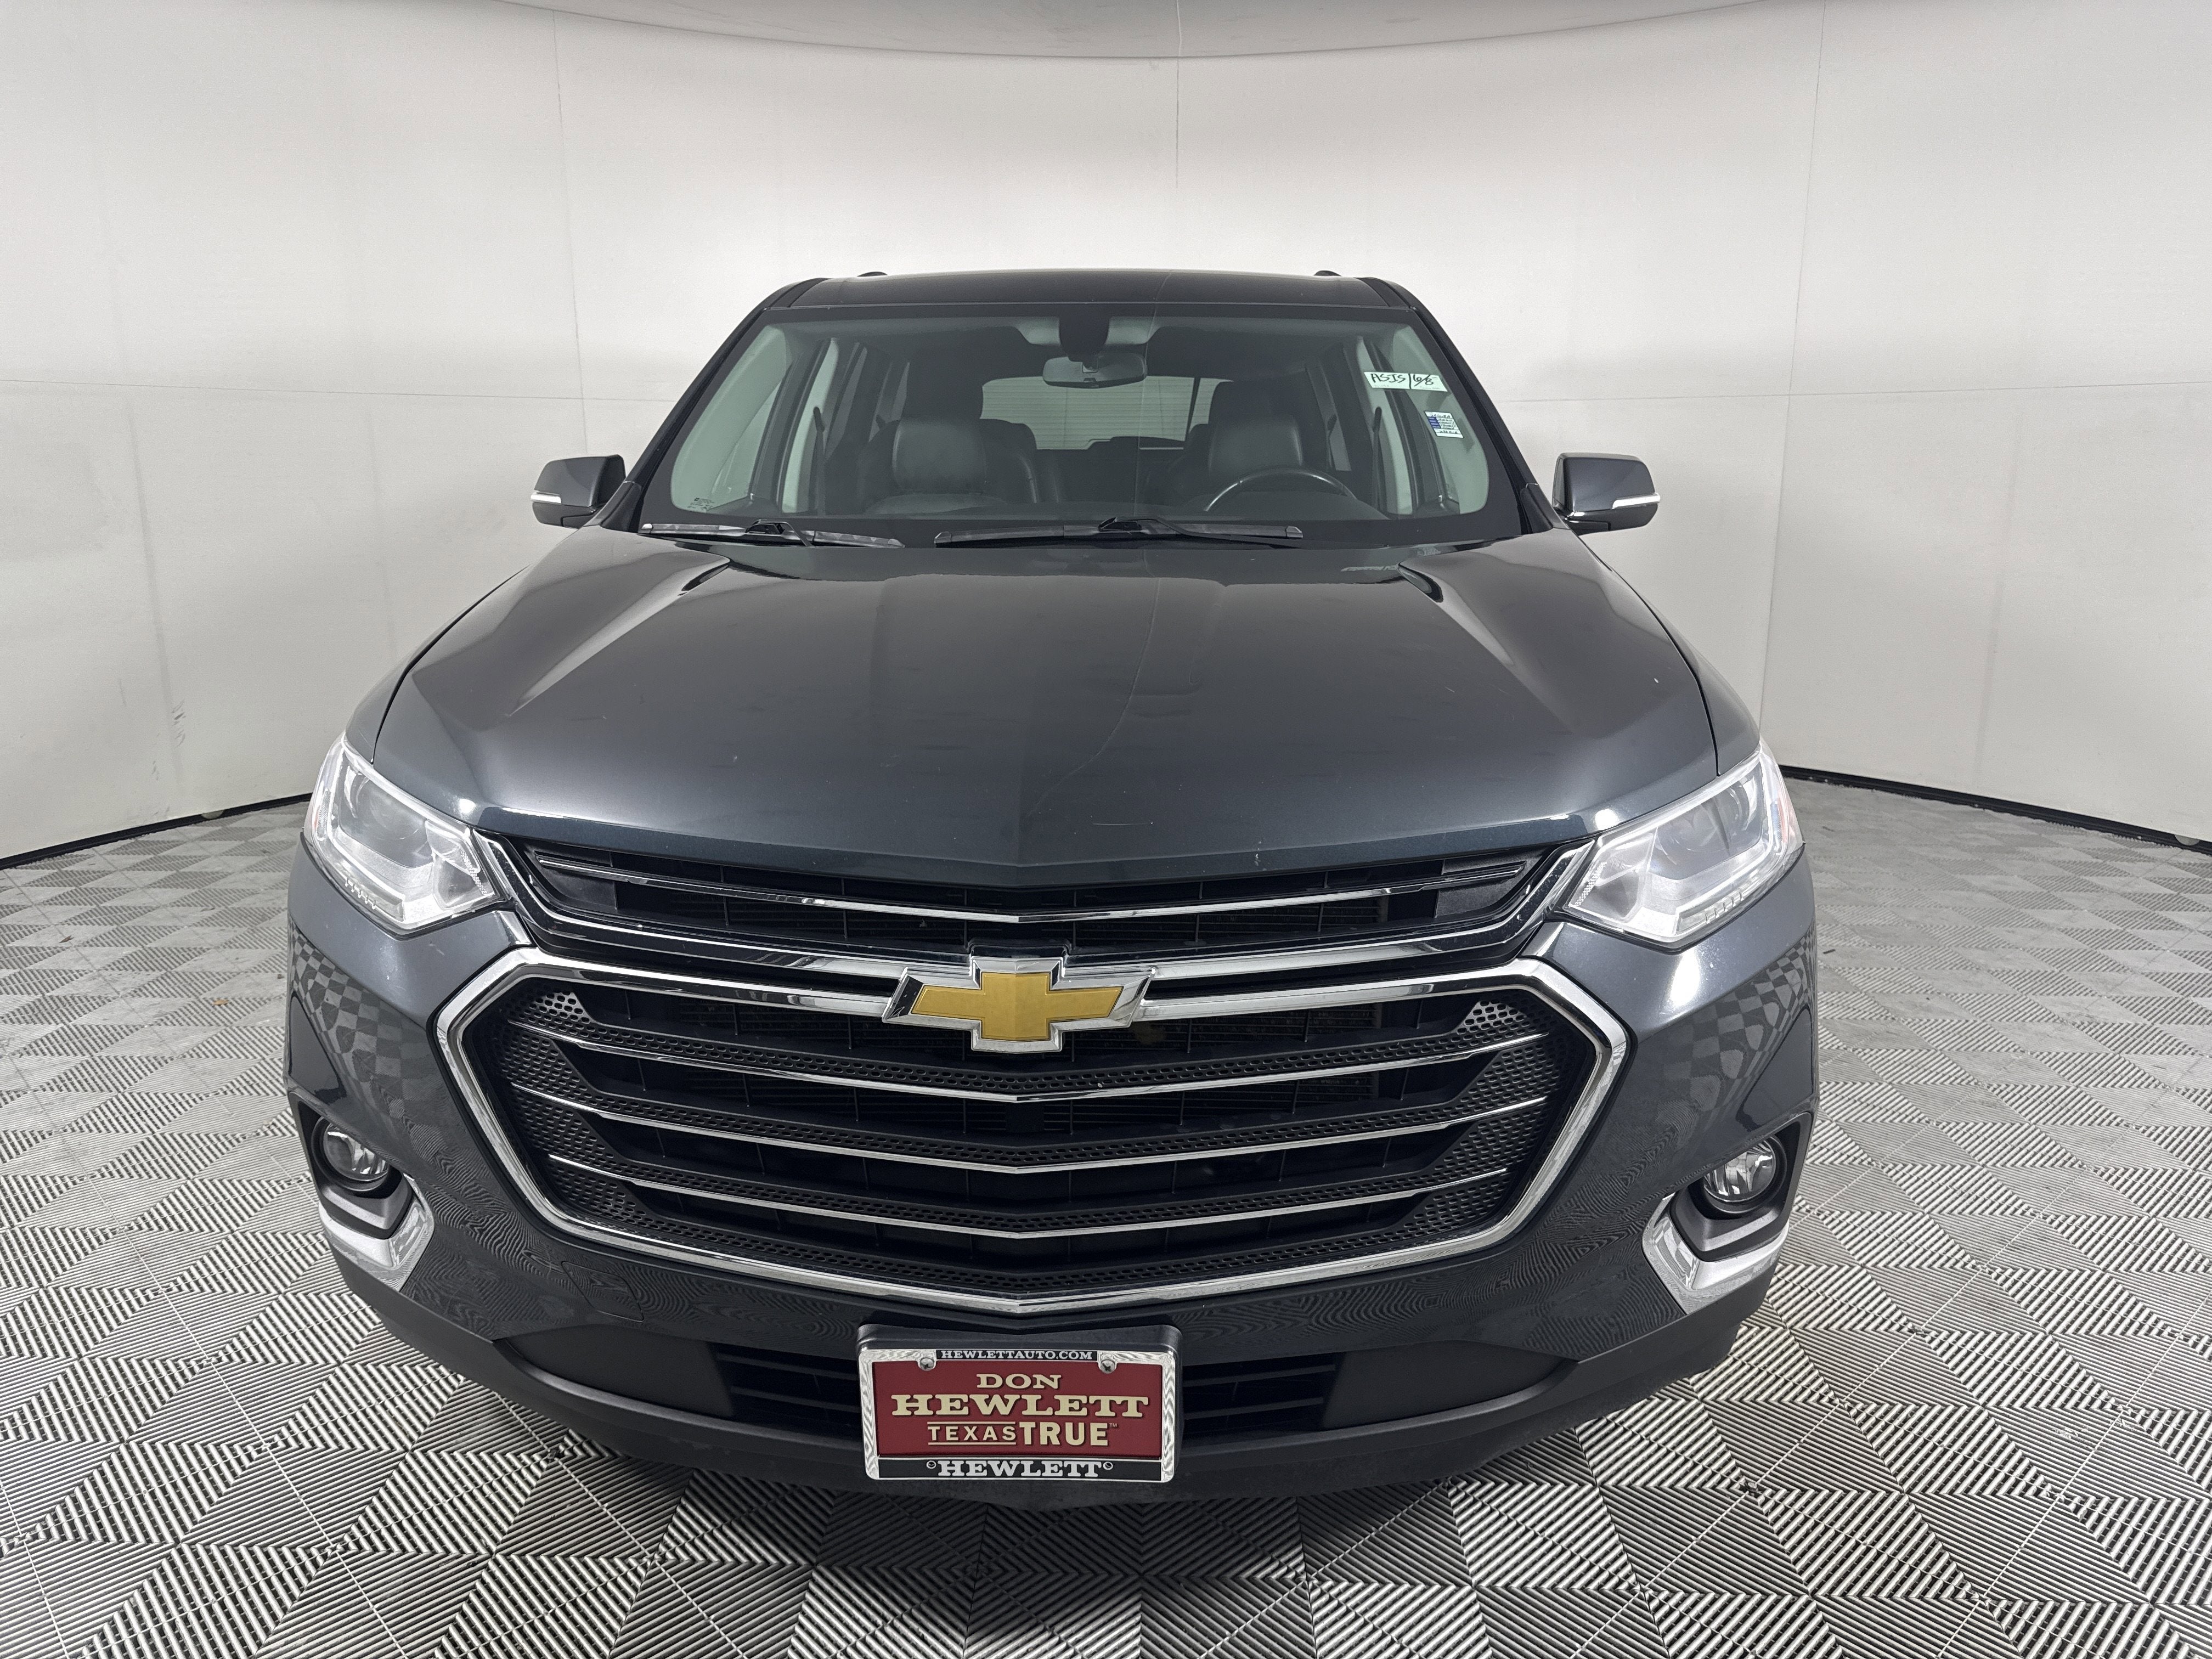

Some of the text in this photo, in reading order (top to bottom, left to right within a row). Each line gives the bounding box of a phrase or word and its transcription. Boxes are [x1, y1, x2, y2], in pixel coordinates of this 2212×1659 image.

[941, 1350, 1092, 1359] HEWLETTAUTO.COM
[977, 1374, 1062, 1389] DON
[891, 1394, 1149, 1417] HEWLETT
[938, 1460, 1102, 1477] HEWLETT
